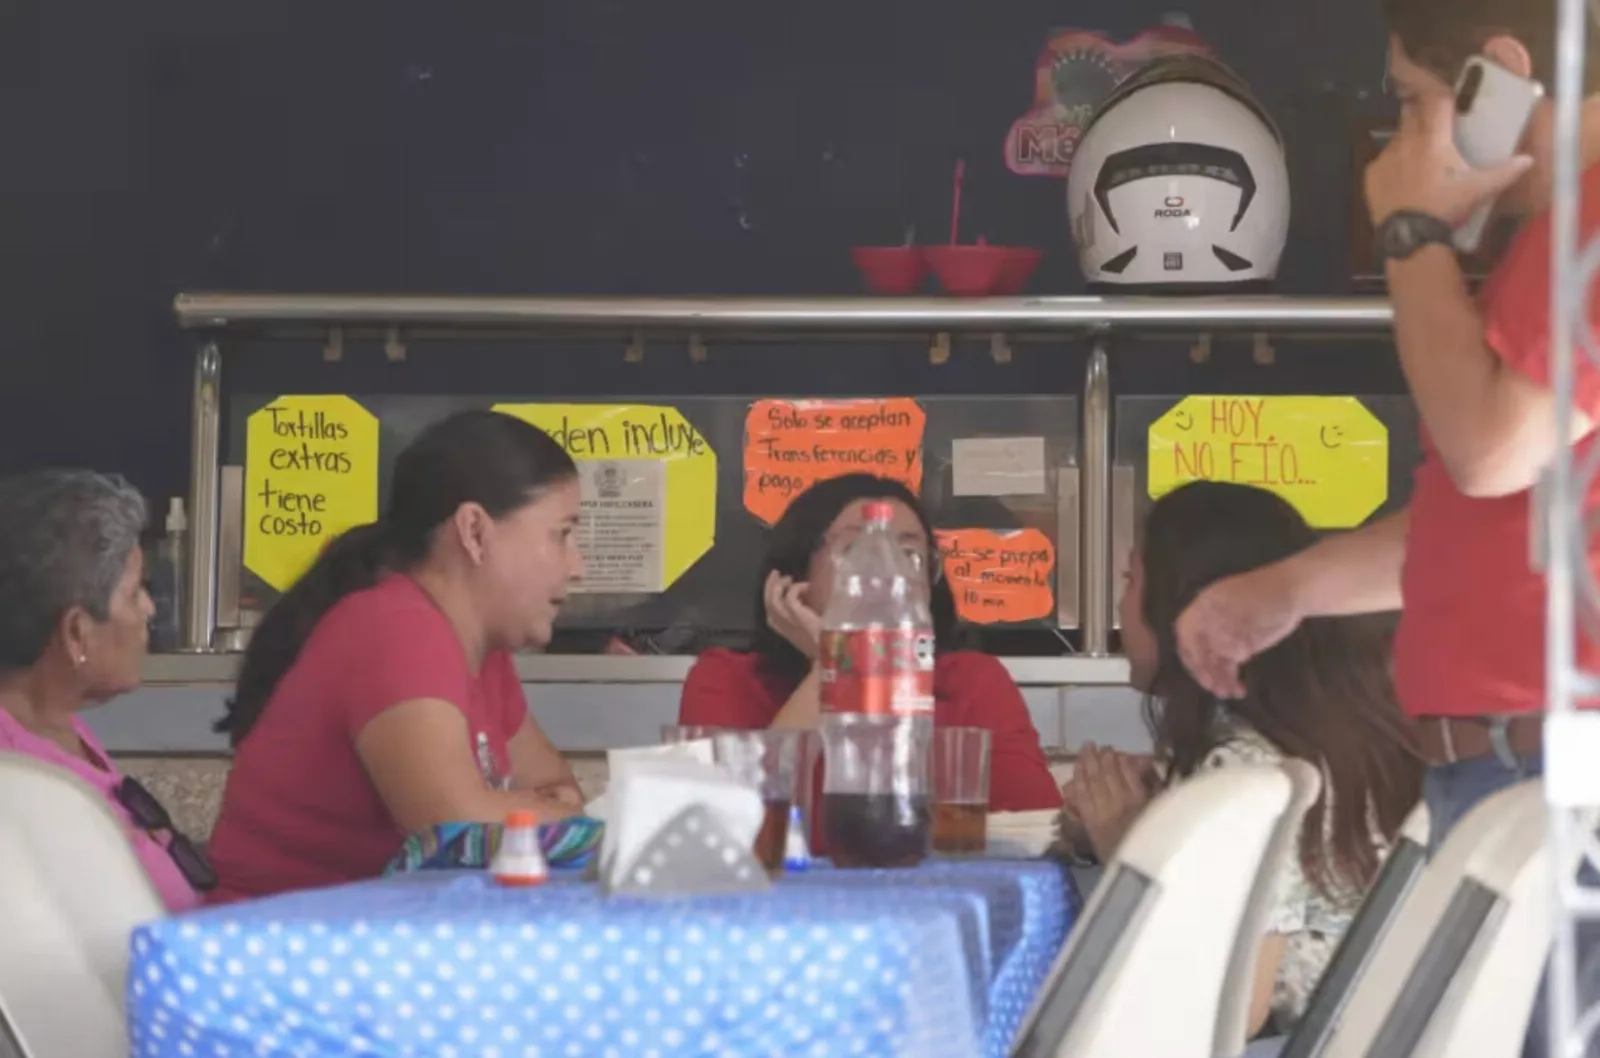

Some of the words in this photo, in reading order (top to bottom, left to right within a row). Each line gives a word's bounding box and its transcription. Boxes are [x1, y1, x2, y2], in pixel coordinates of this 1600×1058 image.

[1154, 208, 1191, 219] RODA
[264, 407, 348, 440] Tortillas
[768, 407, 808, 430] Solo
[815, 413, 833, 428] se
[841, 406, 911, 431] aceptan
[1211, 399, 1264, 439] HOY
[546, 415, 610, 454] den
[622, 412, 704, 457] incluye
[270, 443, 352, 474] extras
[905, 449, 917, 470] y
[1173, 441, 1216, 479] NO
[258, 478, 326, 512] tiene
[758, 474, 804, 496] pago
[259, 512, 322, 535] costo
[954, 562, 971, 578] al
